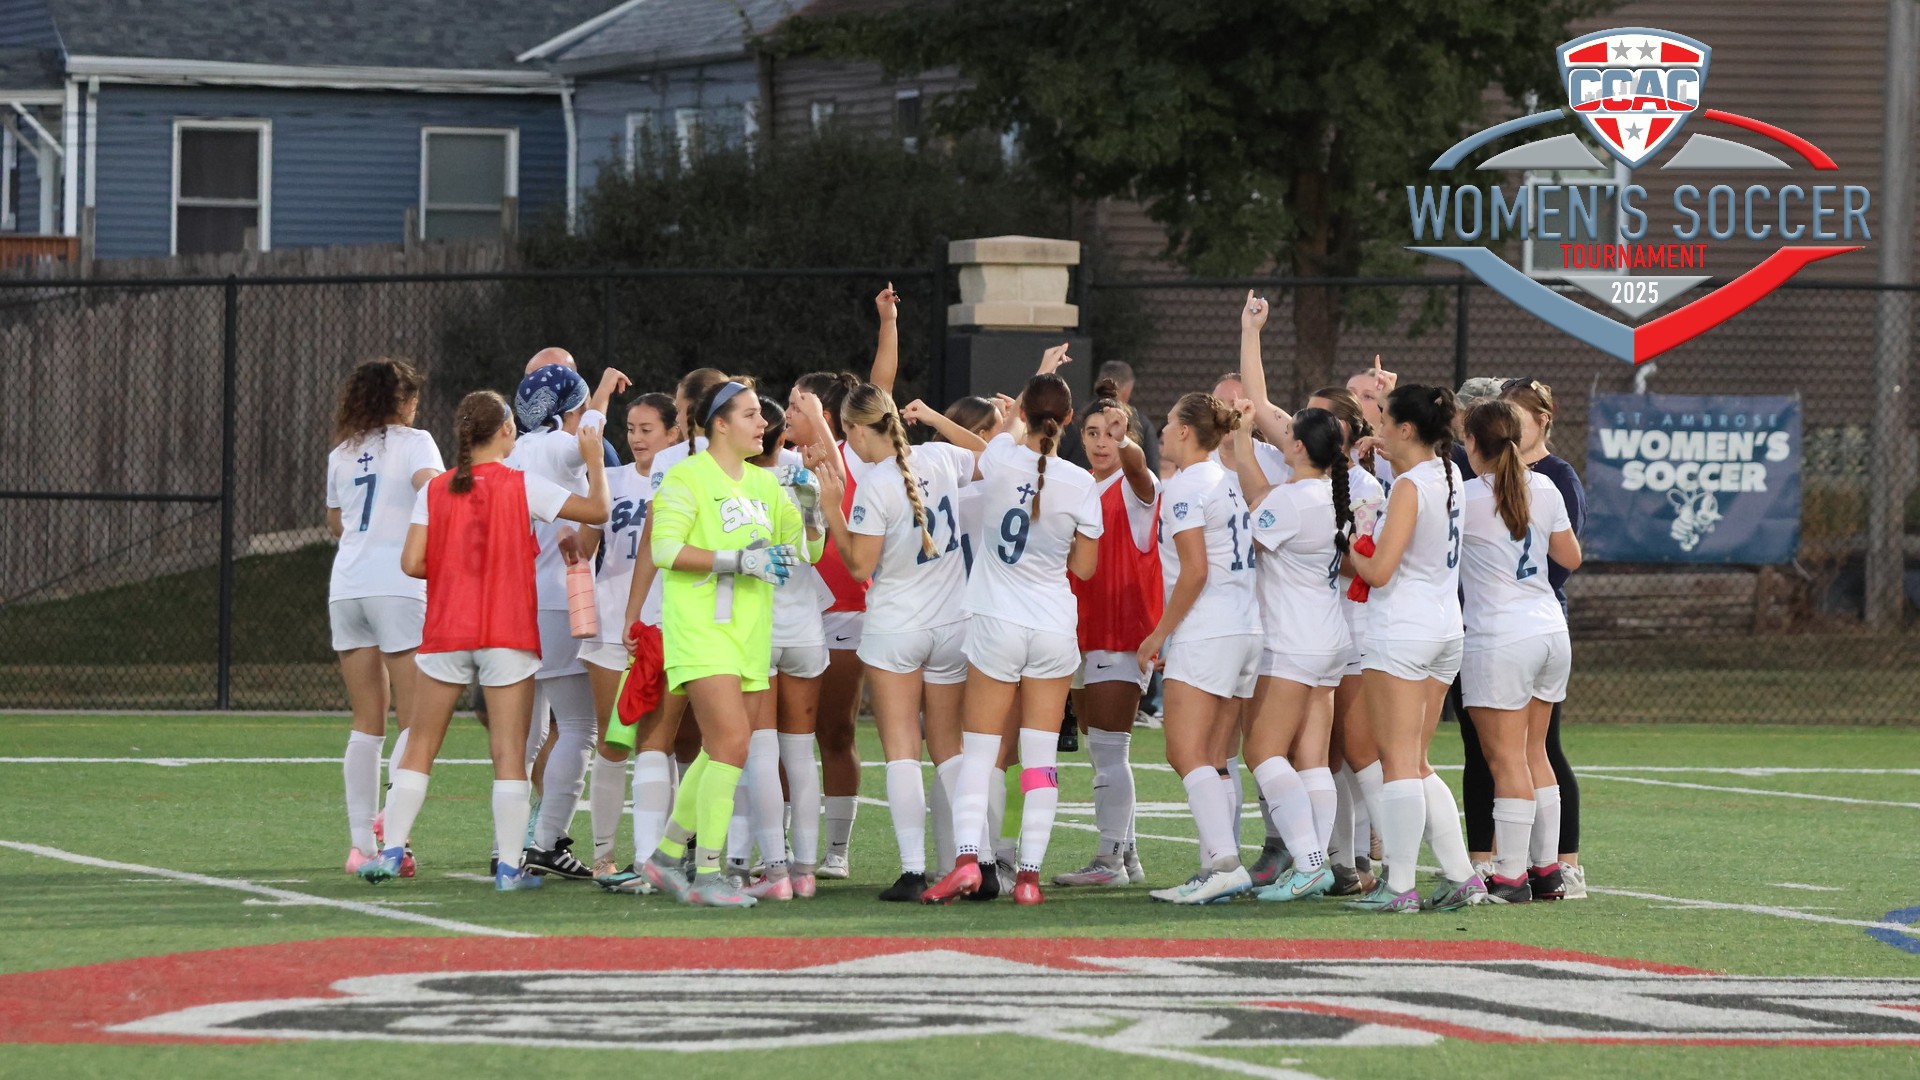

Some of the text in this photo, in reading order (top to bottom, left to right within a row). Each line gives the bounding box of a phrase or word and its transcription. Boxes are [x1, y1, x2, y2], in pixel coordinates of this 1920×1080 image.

[1600, 428, 1791, 462] WOMEN'S
[1662, 413, 1778, 427] AMBROSE
[354, 473, 377, 532] 7
[1621, 460, 1768, 492] SOCCER
[611, 498, 648, 534] SA
[912, 494, 960, 566] 21
[997, 507, 1031, 565] 9
[1446, 508, 1460, 569] 5
[1509, 524, 1538, 581] 2
